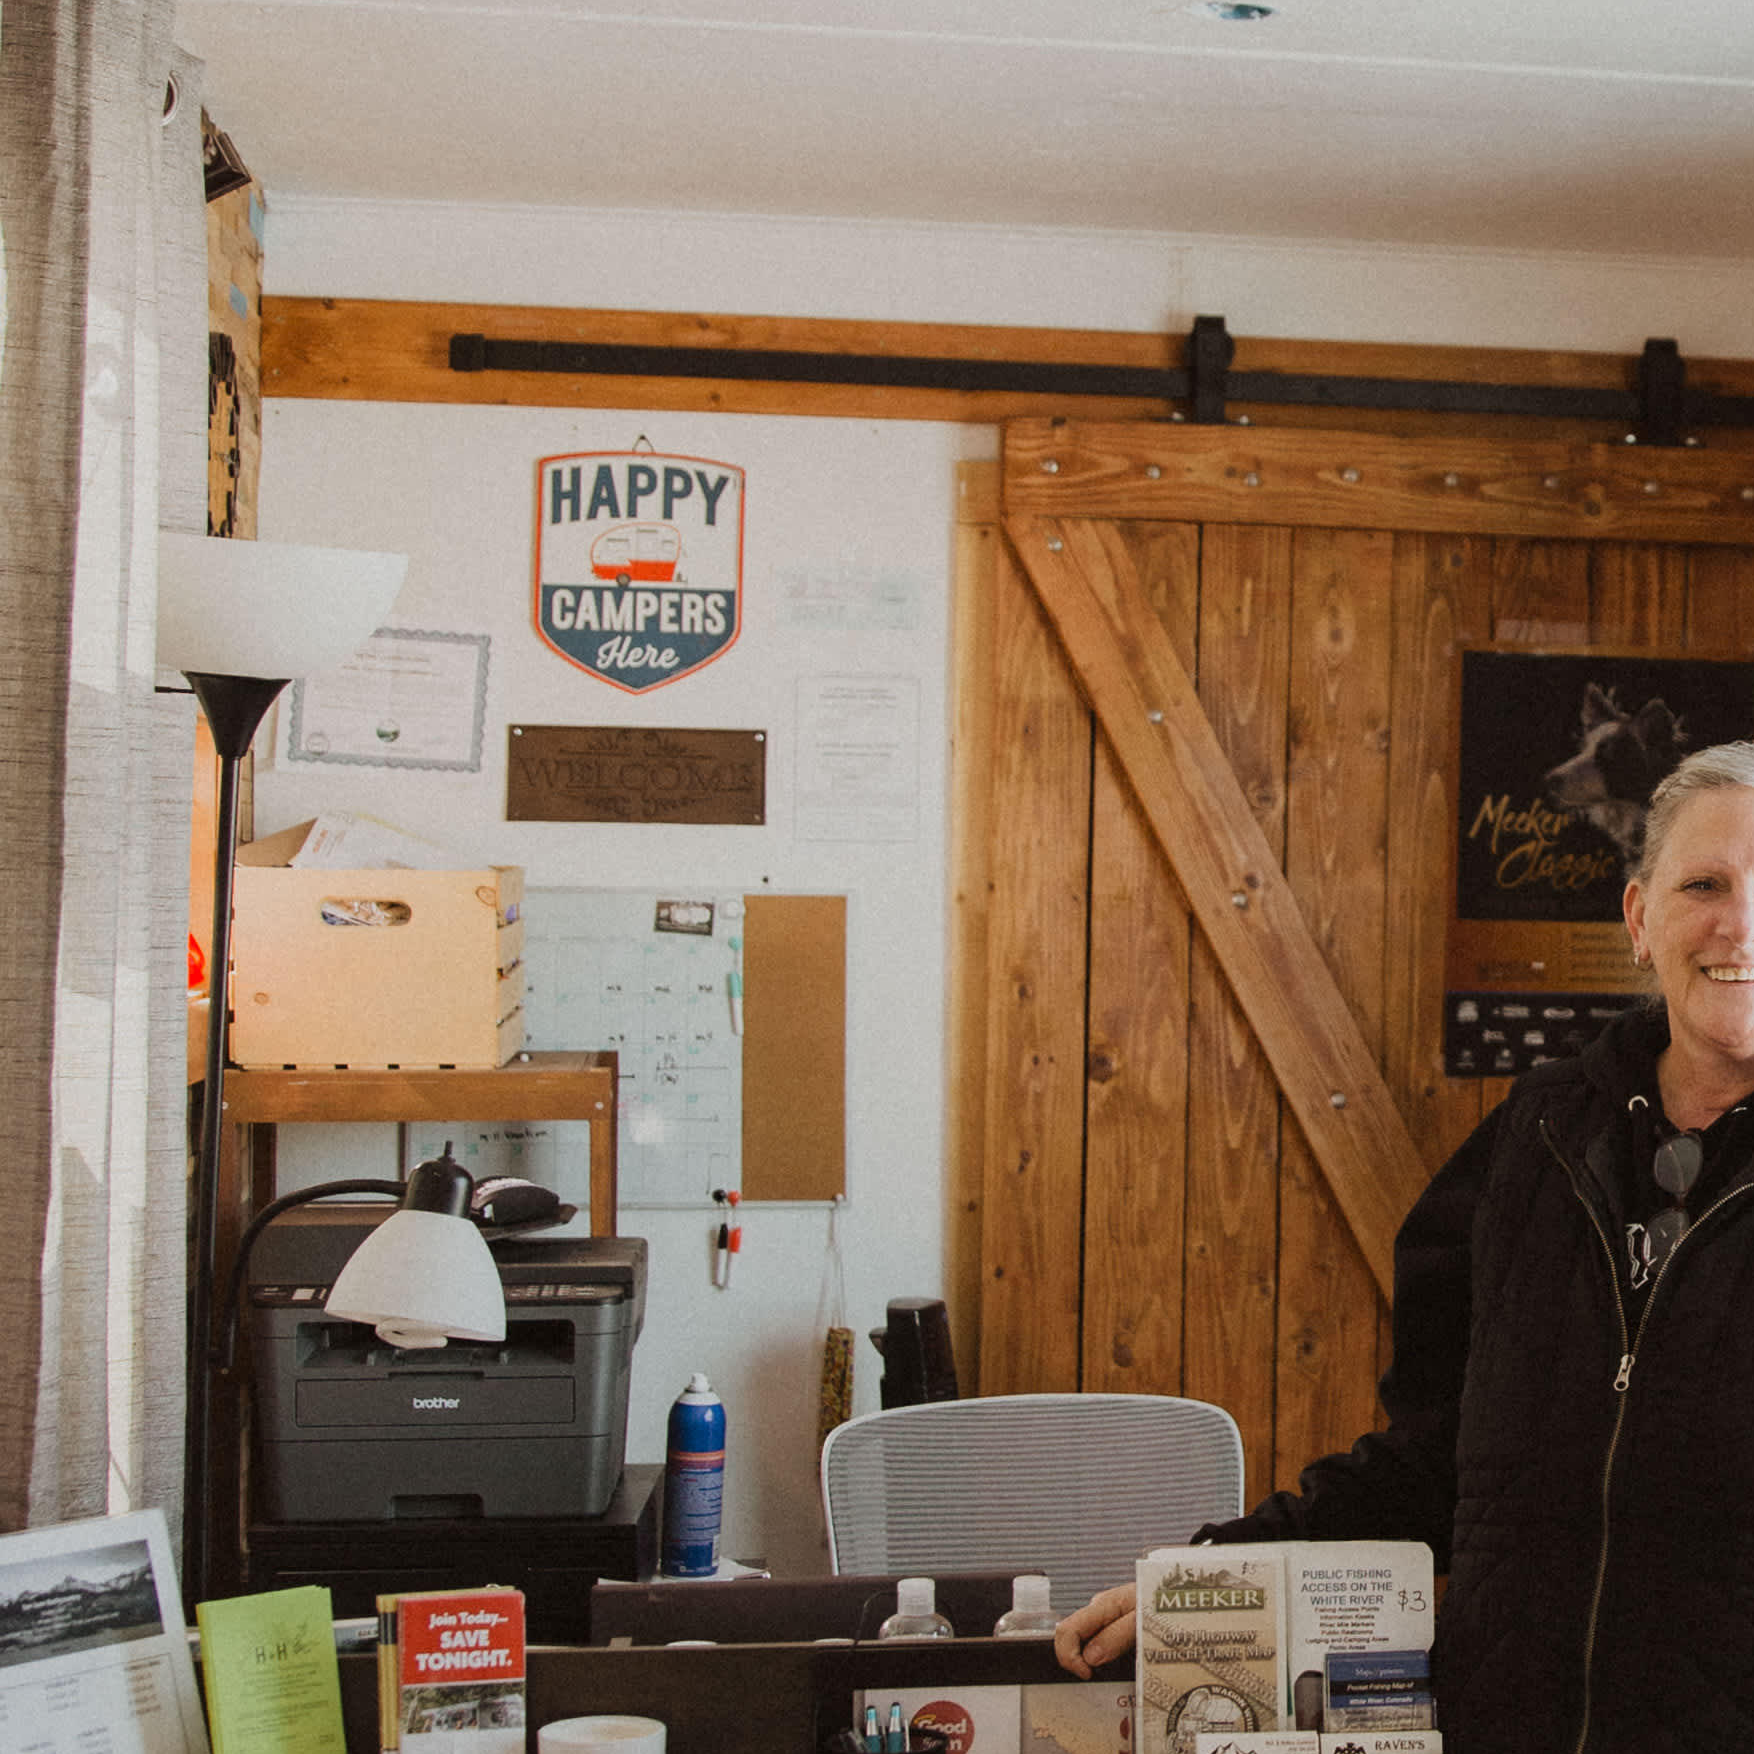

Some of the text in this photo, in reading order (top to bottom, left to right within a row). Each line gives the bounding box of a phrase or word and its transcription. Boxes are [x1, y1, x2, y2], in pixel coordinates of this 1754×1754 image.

[551, 463, 730, 527] HAPPY
[551, 588, 727, 636] CAMPERS
[595, 635, 681, 669] Here
[519, 756, 758, 794] WELCOME
[1468, 793, 1572, 854] Meeker
[413, 1396, 461, 1410] brother
[1302, 1569, 1392, 1580] PUBLIC FISHING
[1301, 1581, 1393, 1592] ACCESS ON THE
[1158, 1589, 1263, 1609] MEEKER
[1310, 1595, 1384, 1606] WHITE RIVER
[1397, 1590, 1426, 1612] $3
[428, 1612, 457, 1630] Join
[440, 1629, 490, 1649] SAVE
[416, 1649, 513, 1672] TONIGHT.
[1374, 1739, 1425, 1751] RAVEN'S
